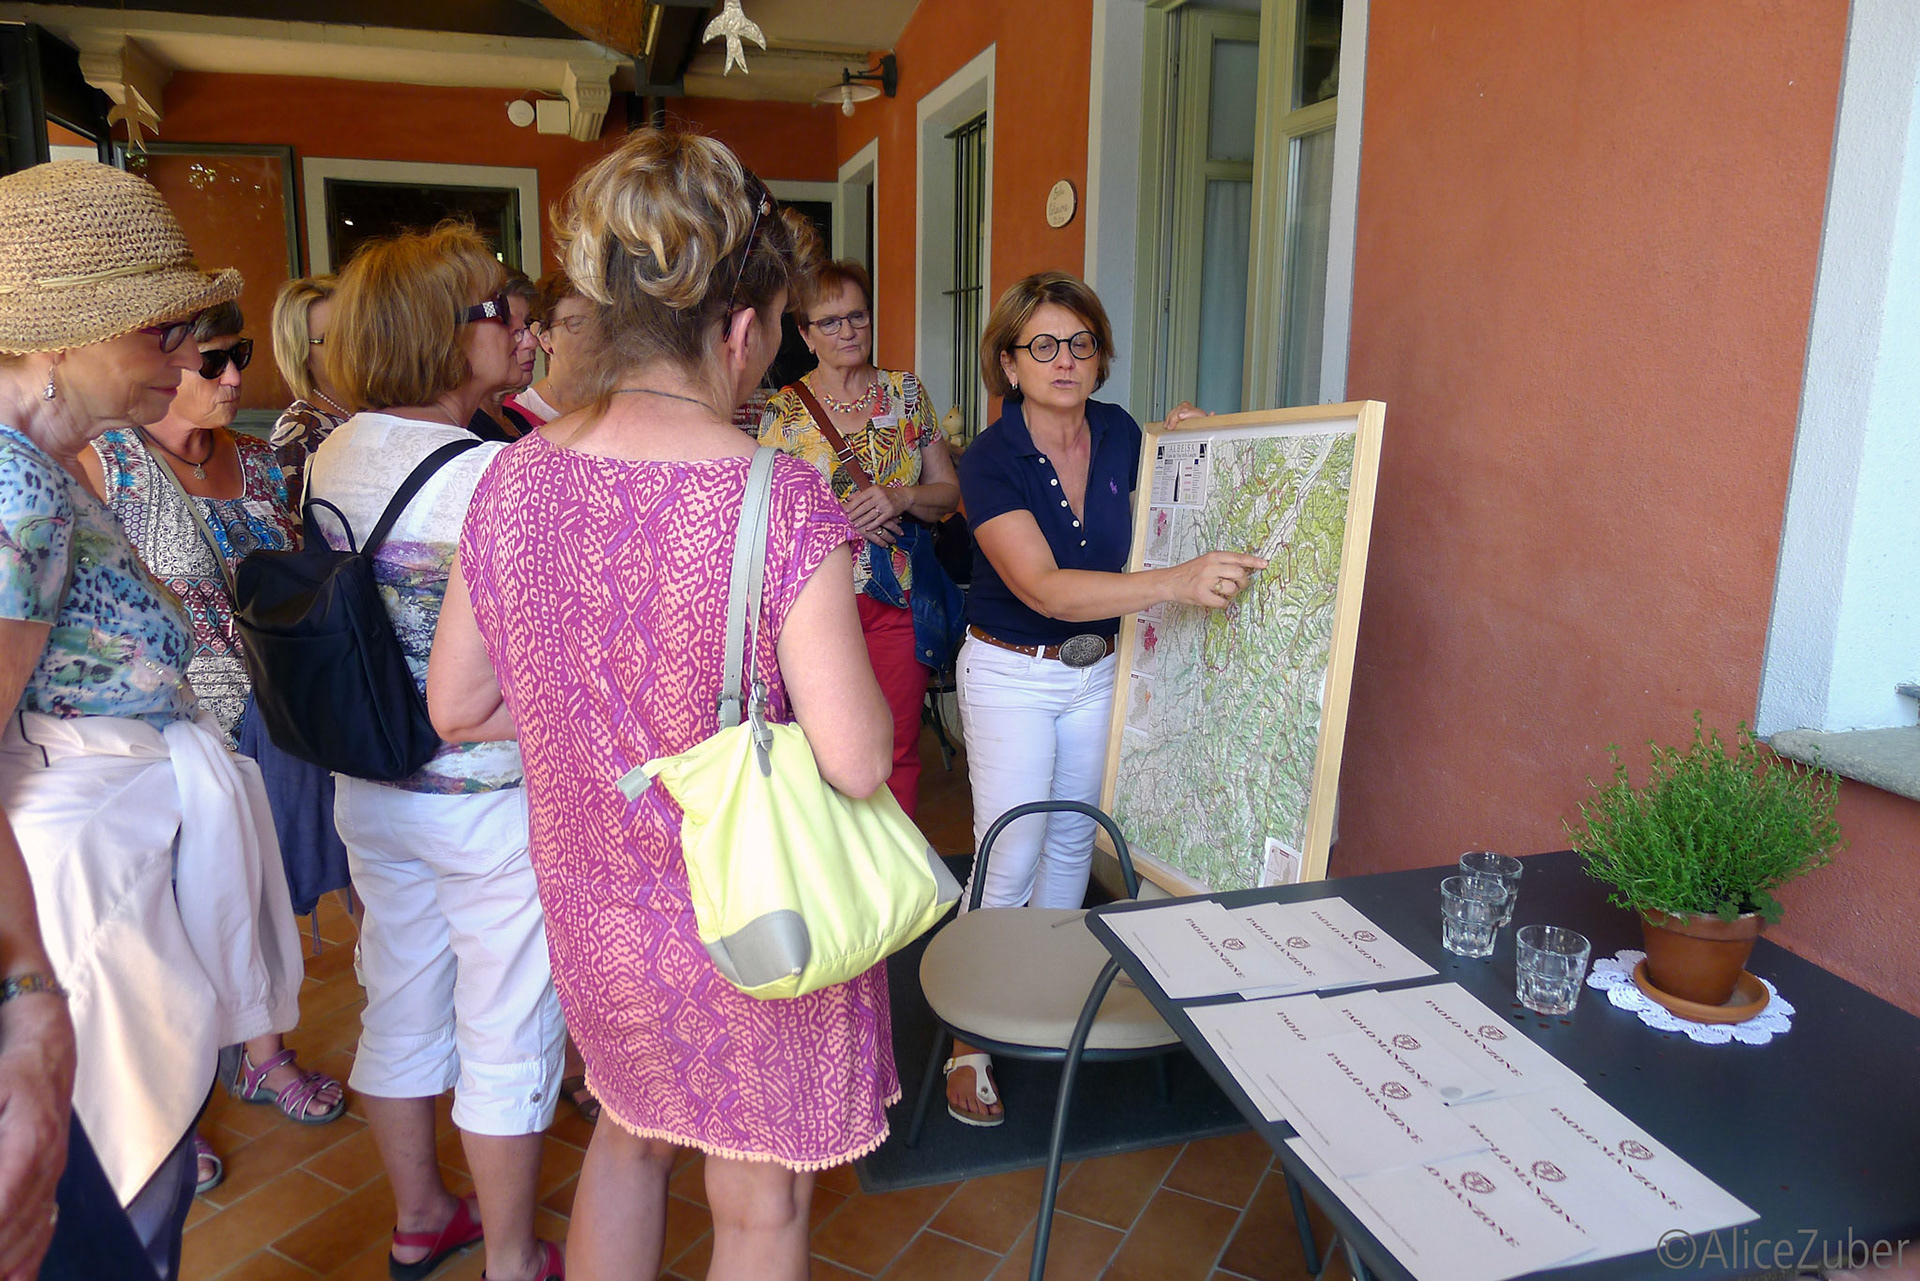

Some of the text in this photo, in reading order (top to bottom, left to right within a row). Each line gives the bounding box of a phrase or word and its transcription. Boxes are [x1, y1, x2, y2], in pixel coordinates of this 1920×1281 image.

[1185, 917, 1246, 979] PAOLO MANZONE
[1246, 917, 1316, 977] PAOLO MANZONE
[1310, 910, 1386, 970] PAOLO MANZONE
[1276, 1011, 1307, 1042] PAOLO
[1341, 1008, 1433, 1088] PAOLO MANZONE
[1425, 1000, 1523, 1077] PAOLO MANZONE
[1327, 1052, 1364, 1087] PAOLO
[1360, 1086, 1424, 1144] MANZONE
[1550, 1107, 1683, 1211] PAOLO MANZONE
[1438, 1177, 1521, 1249] MANZONE
